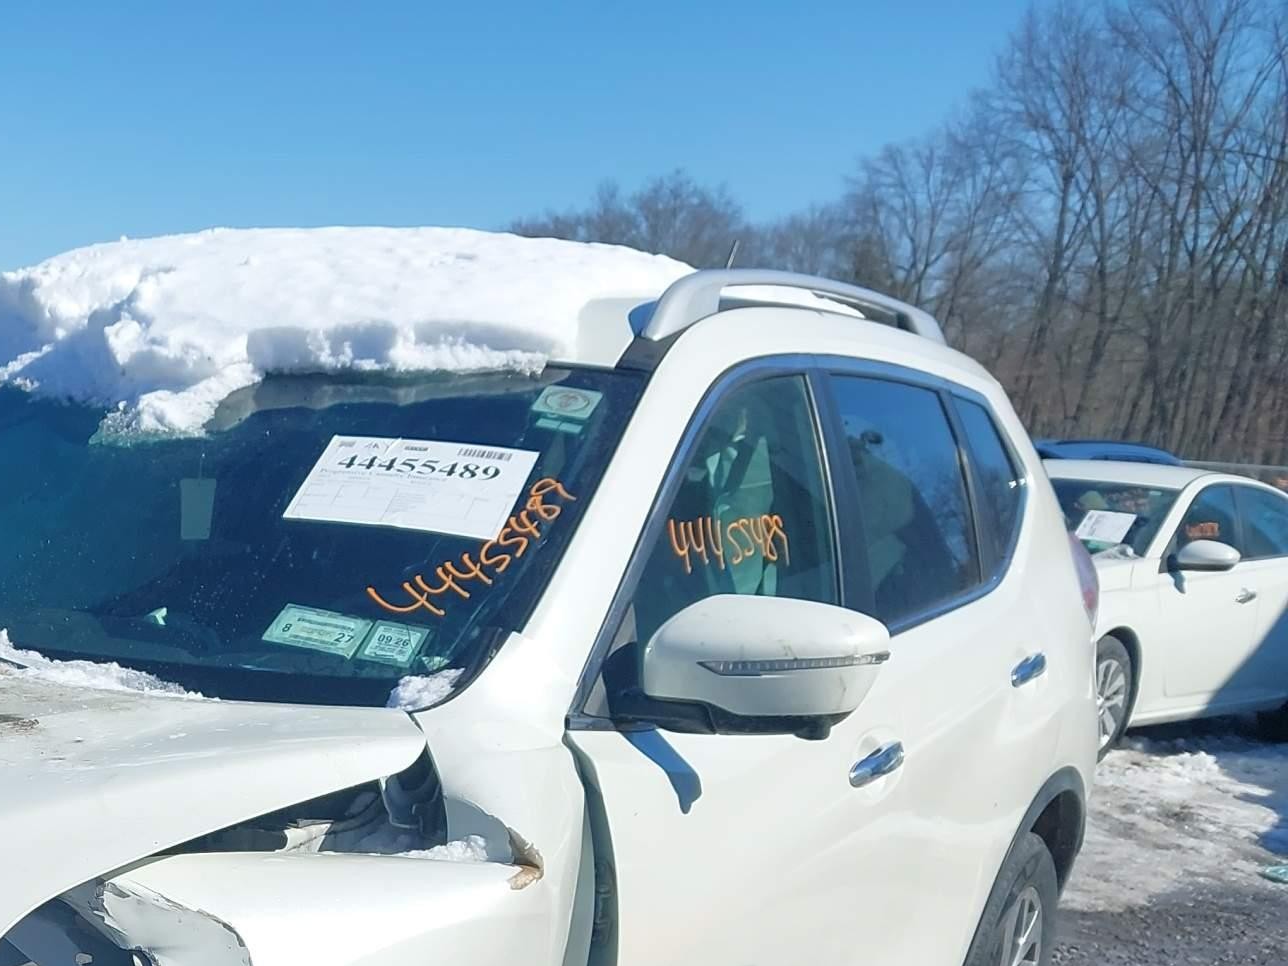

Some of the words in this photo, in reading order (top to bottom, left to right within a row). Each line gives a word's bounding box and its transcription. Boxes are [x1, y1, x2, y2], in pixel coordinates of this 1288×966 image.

[337, 453, 501, 481] 44455489
[366, 477, 577, 616] 44455489
[667, 513, 791, 575] 44455489
[281, 623, 293, 633] 8
[333, 632, 354, 644] 27
